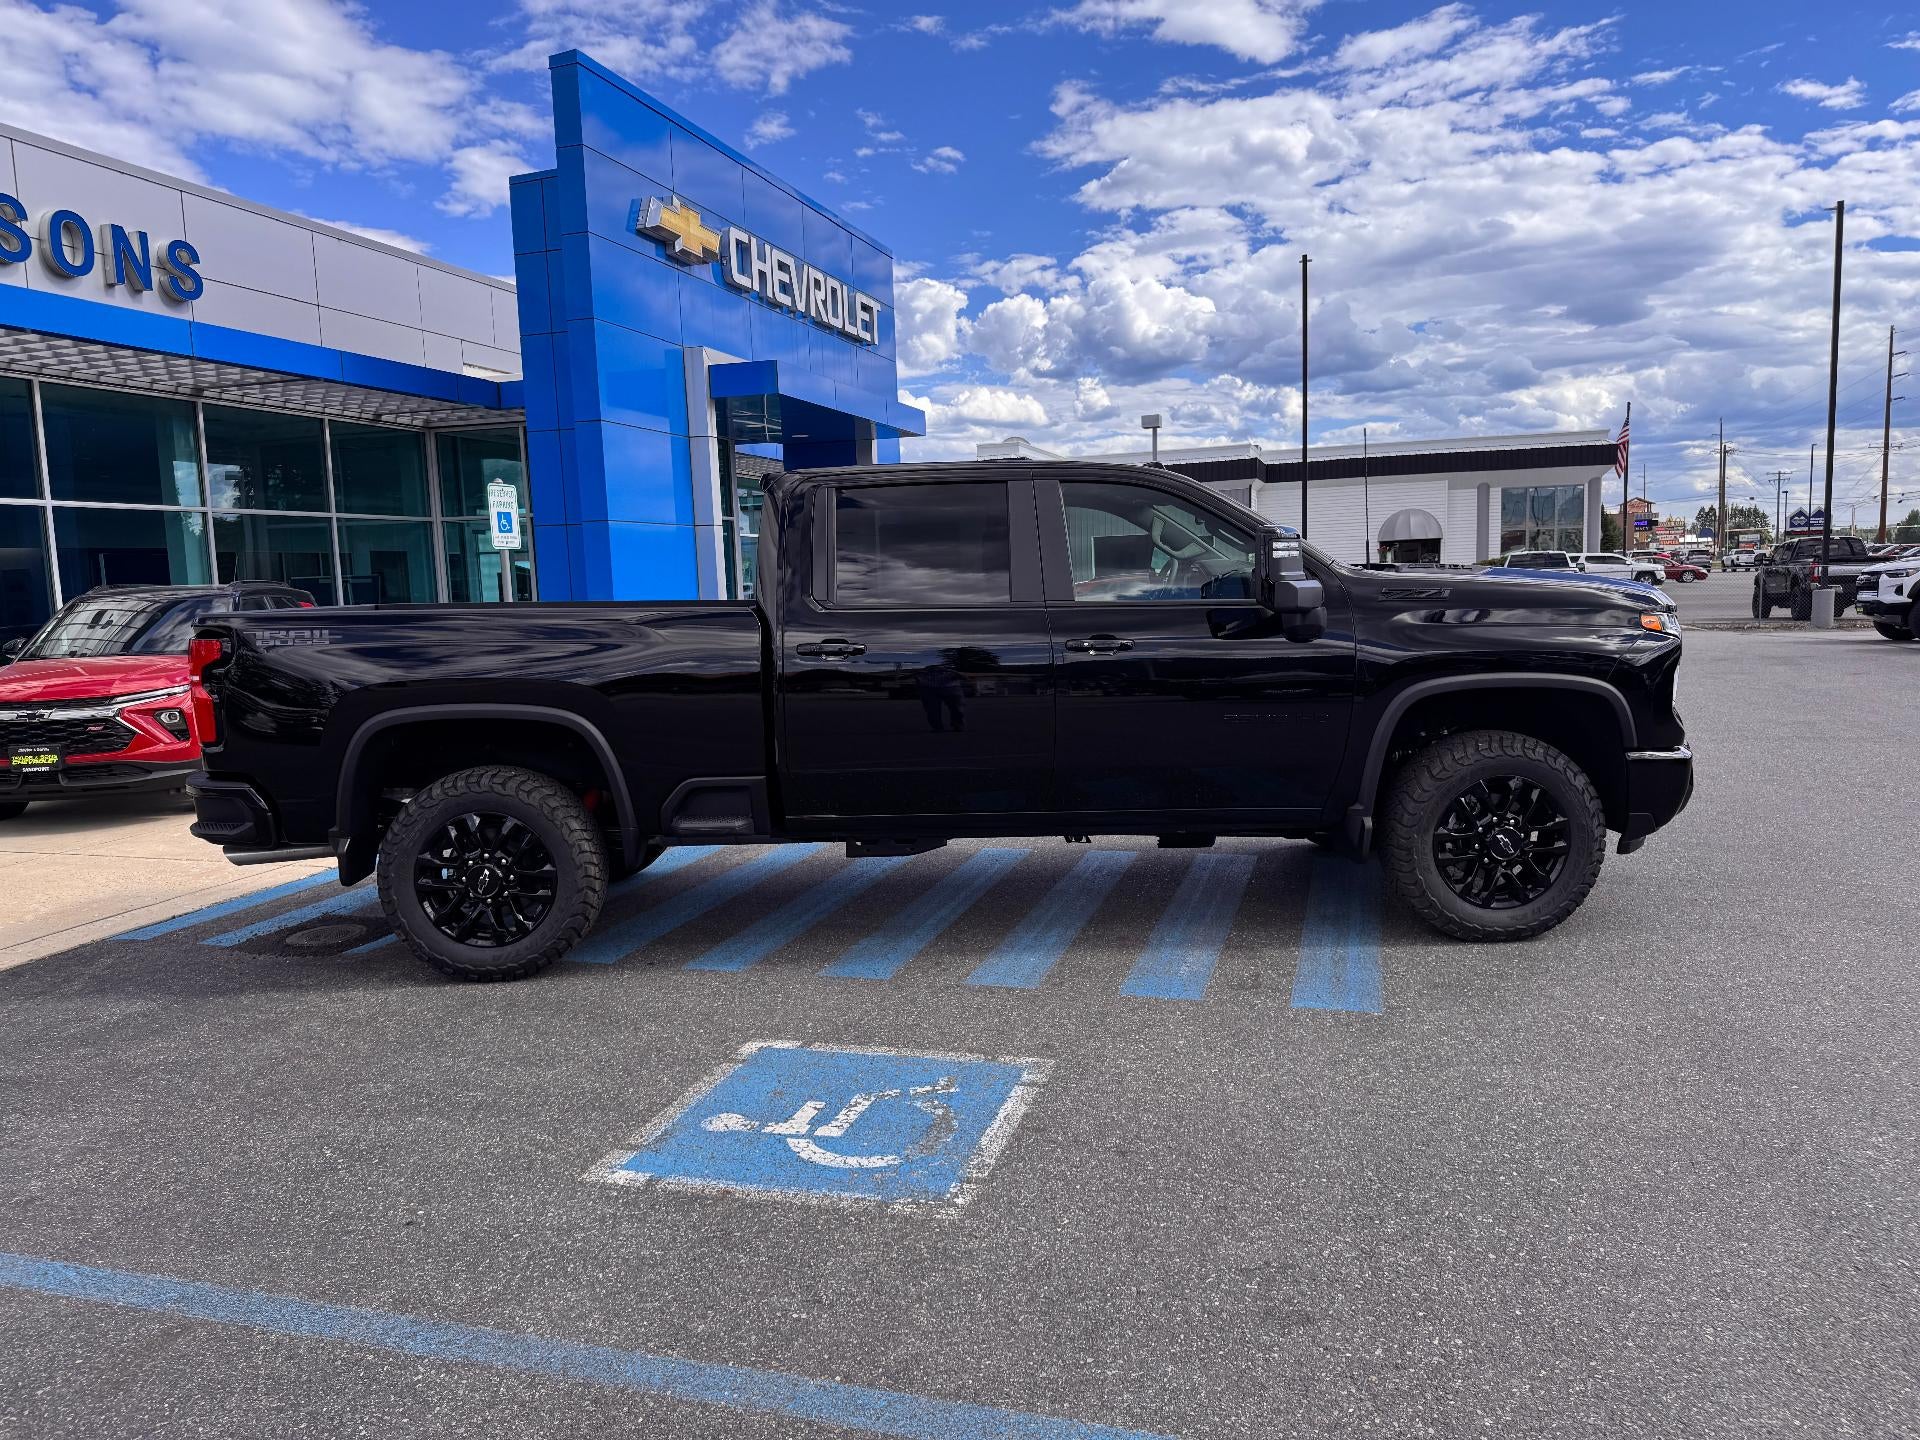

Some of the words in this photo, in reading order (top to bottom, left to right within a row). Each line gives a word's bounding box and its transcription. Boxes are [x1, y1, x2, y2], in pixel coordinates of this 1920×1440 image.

[0, 193, 204, 301] SONS
[720, 226, 881, 346] CHEVROLET
[490, 488, 515, 499] RESERVED
[492, 501, 514, 510] PARKING
[1380, 587, 1454, 601] Z71
[243, 629, 342, 639] TRAIL
[255, 639, 330, 647] BOSS
